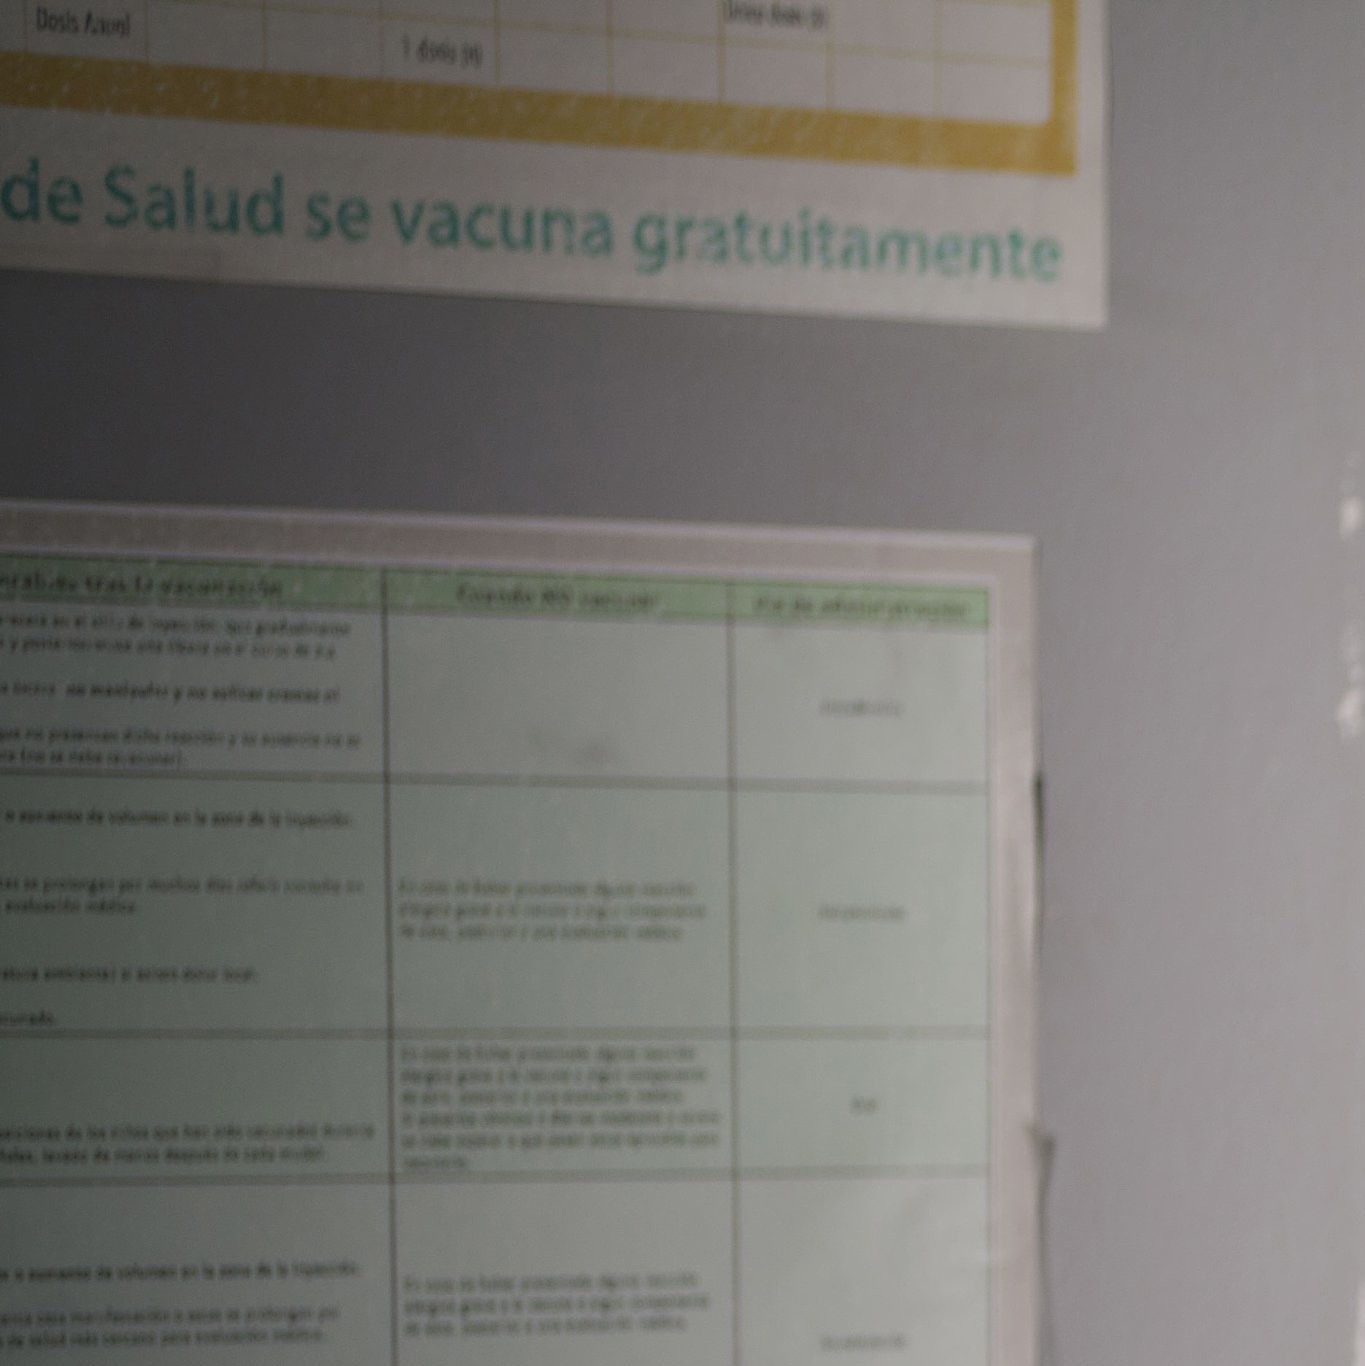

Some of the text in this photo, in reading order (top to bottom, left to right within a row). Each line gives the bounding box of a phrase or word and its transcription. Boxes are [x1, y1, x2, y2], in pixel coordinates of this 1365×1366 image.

[1, 157, 1064, 283] de Salud se vacuna gratuitamente
